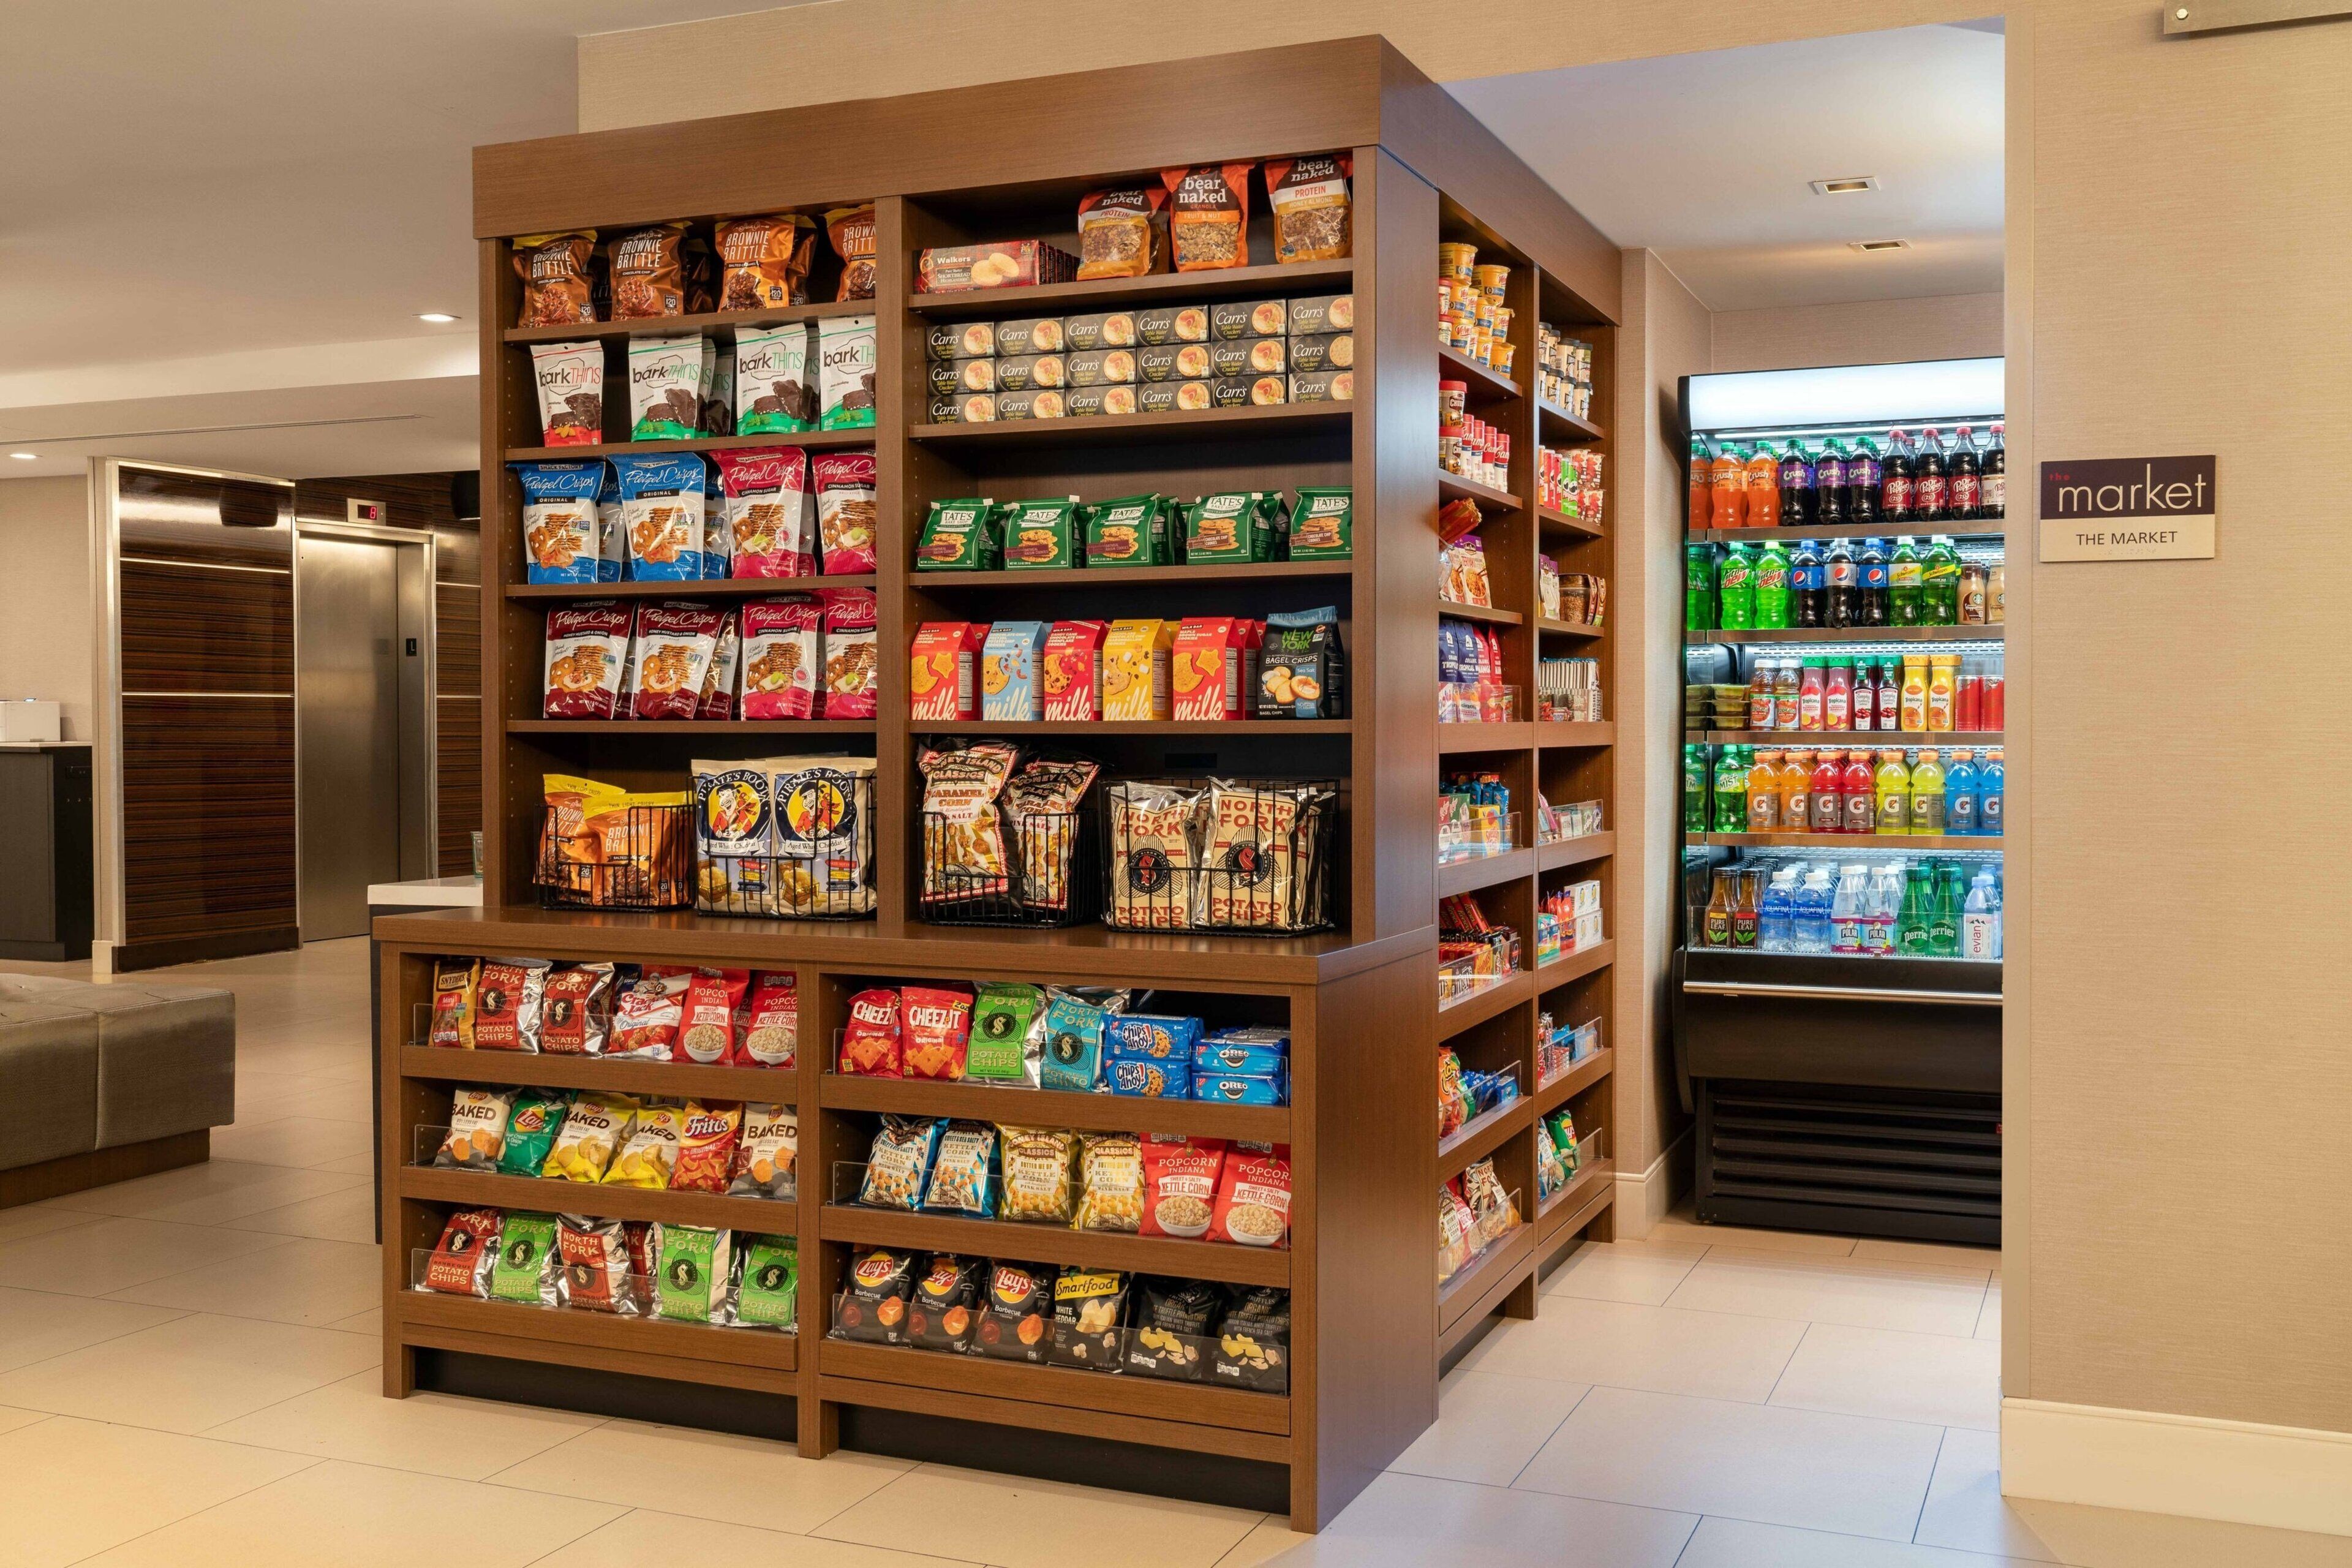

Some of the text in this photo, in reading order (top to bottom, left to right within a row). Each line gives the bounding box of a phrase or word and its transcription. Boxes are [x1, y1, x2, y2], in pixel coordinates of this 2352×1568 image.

[1297, 159, 1332, 172] bear
[1291, 165, 1334, 182] naked
[1185, 177, 1221, 190] bear
[1178, 190, 1227, 203] naked
[1295, 186, 1326, 197] PROTEIN
[1289, 199, 1308, 208] HONEY
[726, 231, 770, 246] BROWNIE
[620, 239, 662, 255] BROWNIE
[617, 254, 660, 268] BRITTLE
[533, 262, 574, 277] BRITTLE
[1216, 312, 1247, 325] Carr's
[1294, 306, 1324, 319] Carr's
[1069, 323, 1098, 336] Carr's
[1140, 318, 1170, 330] Carr's
[932, 333, 959, 345] Carr's
[1000, 329, 1028, 341] Carr's
[1000, 364, 1028, 377] Carr's
[1070, 360, 1099, 372] Carr's
[932, 368, 960, 380] Carr's
[1713, 471, 1733, 482] Crush
[1749, 471, 1770, 481] Crush
[1784, 469, 1805, 480] Crush
[1819, 467, 1840, 478] Crush
[1887, 483, 1909, 494] Pepper
[1920, 482, 1942, 493] Pepper
[1954, 482, 1975, 492] Pepper
[2059, 464, 2206, 511] market
[1315, 498, 1348, 507] TATE'S
[370, 507, 375, 519] 8
[943, 511, 973, 520] TATE'S
[2076, 532, 2177, 545] THE MARKET
[1282, 631, 1313, 641] NEW
[410, 641, 415, 651] L
[1281, 639, 1310, 650] YORK
[912, 685, 956, 720] milk
[984, 685, 1030, 720] milk
[1046, 685, 1091, 720] milk
[1175, 684, 1224, 720] milk
[966, 756, 1001, 772] ISLAND
[1720, 777, 1738, 788] MIST
[1221, 799, 1292, 816] NORTH
[1753, 796, 1766, 812] G
[1790, 796, 1804, 812] G
[1819, 796, 1833, 812] G
[1849, 797, 1865, 813] G
[1122, 810, 1185, 825] NORTH
[1219, 814, 1287, 832] FORK
[1120, 822, 1182, 837] FORK
[1213, 897, 1281, 912] POTATO
[1869, 930, 1885, 938] POLAR
[482, 971, 520, 984] FORK
[982, 997, 1030, 1008] FORK
[1058, 1003, 1100, 1016] NORTH
[619, 1020, 649, 1029] Original
[1053, 1011, 1096, 1027] FORK
[1123, 1025, 1145, 1039] Chips
[972, 1050, 1018, 1059] POTATO
[1219, 1049, 1249, 1059] OREO
[971, 1058, 1017, 1068] CHIPS
[1117, 1065, 1140, 1079] Chips
[1219, 1081, 1248, 1090] OREO
[685, 1116, 728, 1136] Fritos
[748, 1123, 797, 1139] BAKED
[879, 1147, 911, 1160] KETTLE
[881, 1155, 905, 1165] CORN
[1159, 1158, 1218, 1167] POPCORN
[1248, 1176, 1284, 1186] INDIANA
[1162, 1183, 1209, 1194] KETTLE CORN
[564, 1232, 598, 1245] NORTH
[564, 1241, 598, 1257] FORK
[666, 1239, 710, 1254] FORK
[432, 1265, 470, 1276] POTATO
[858, 1261, 890, 1278] Lay's
[430, 1273, 467, 1284] CHIPS
[998, 1270, 1031, 1292] Lay's
[1057, 1278, 1114, 1295] Smartfood
[855, 1289, 880, 1298] Barbecue
[1248, 1295, 1275, 1304] TRUFFLES
[922, 1297, 946, 1307] Barbecue
[1245, 1303, 1272, 1313] ORGANIC
[995, 1305, 1021, 1316] Barbecue
[1057, 1306, 1072, 1314] WHITE
